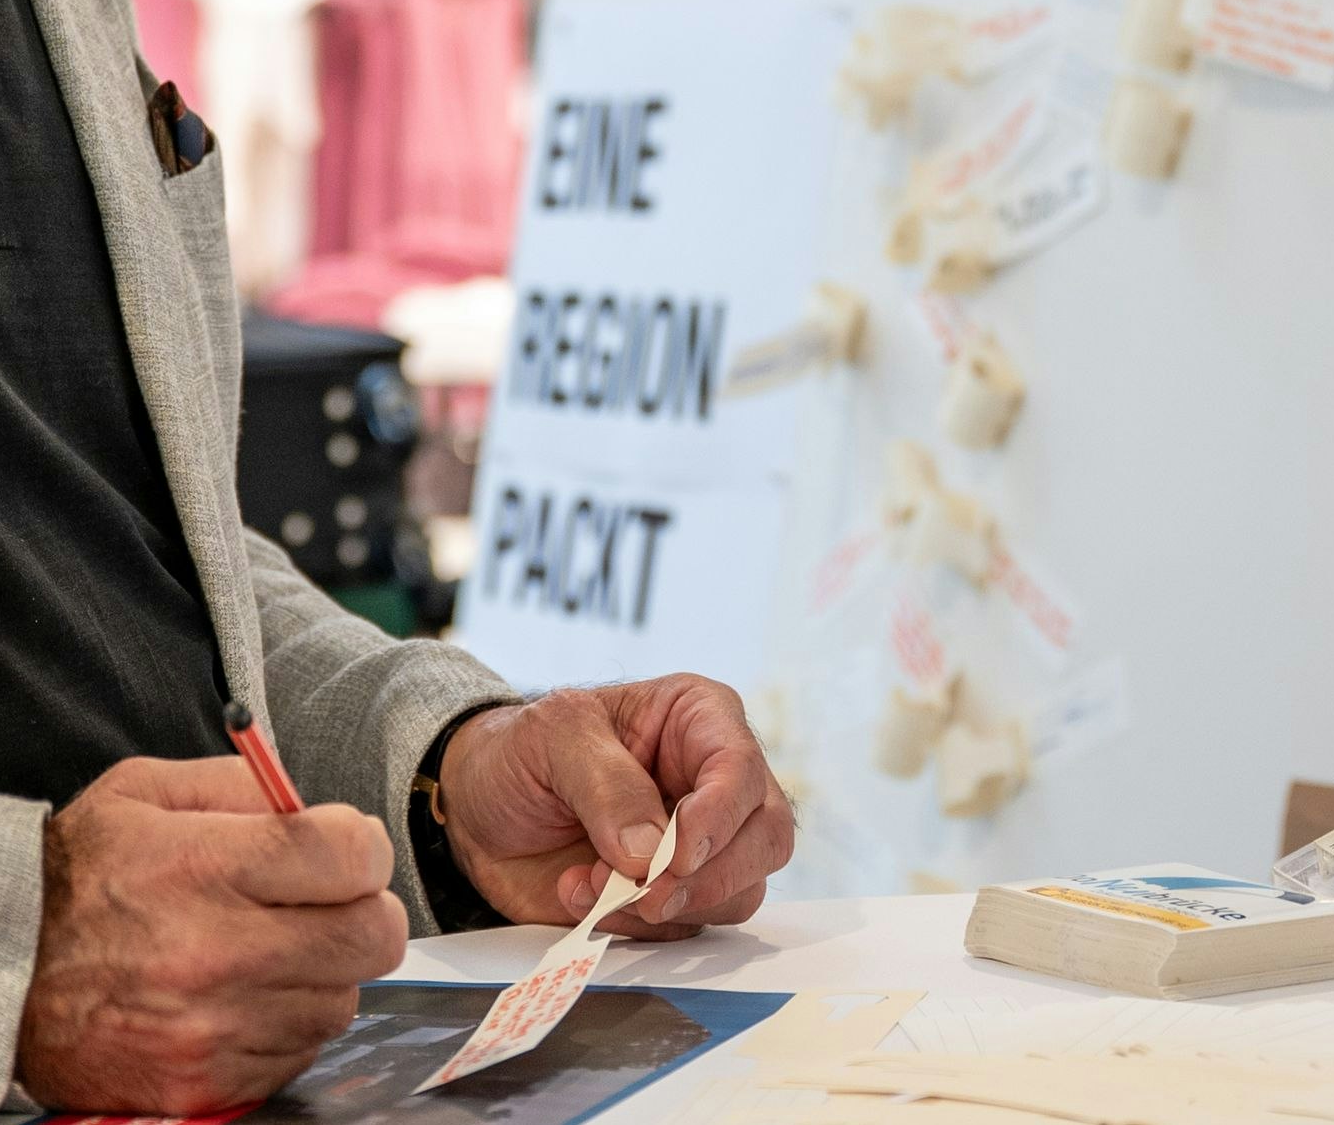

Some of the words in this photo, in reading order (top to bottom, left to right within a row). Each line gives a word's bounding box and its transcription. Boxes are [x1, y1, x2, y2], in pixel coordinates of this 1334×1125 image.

[537, 95, 670, 213] EINE
[508, 292, 729, 423] REGION
[481, 485, 676, 629] PACKT
